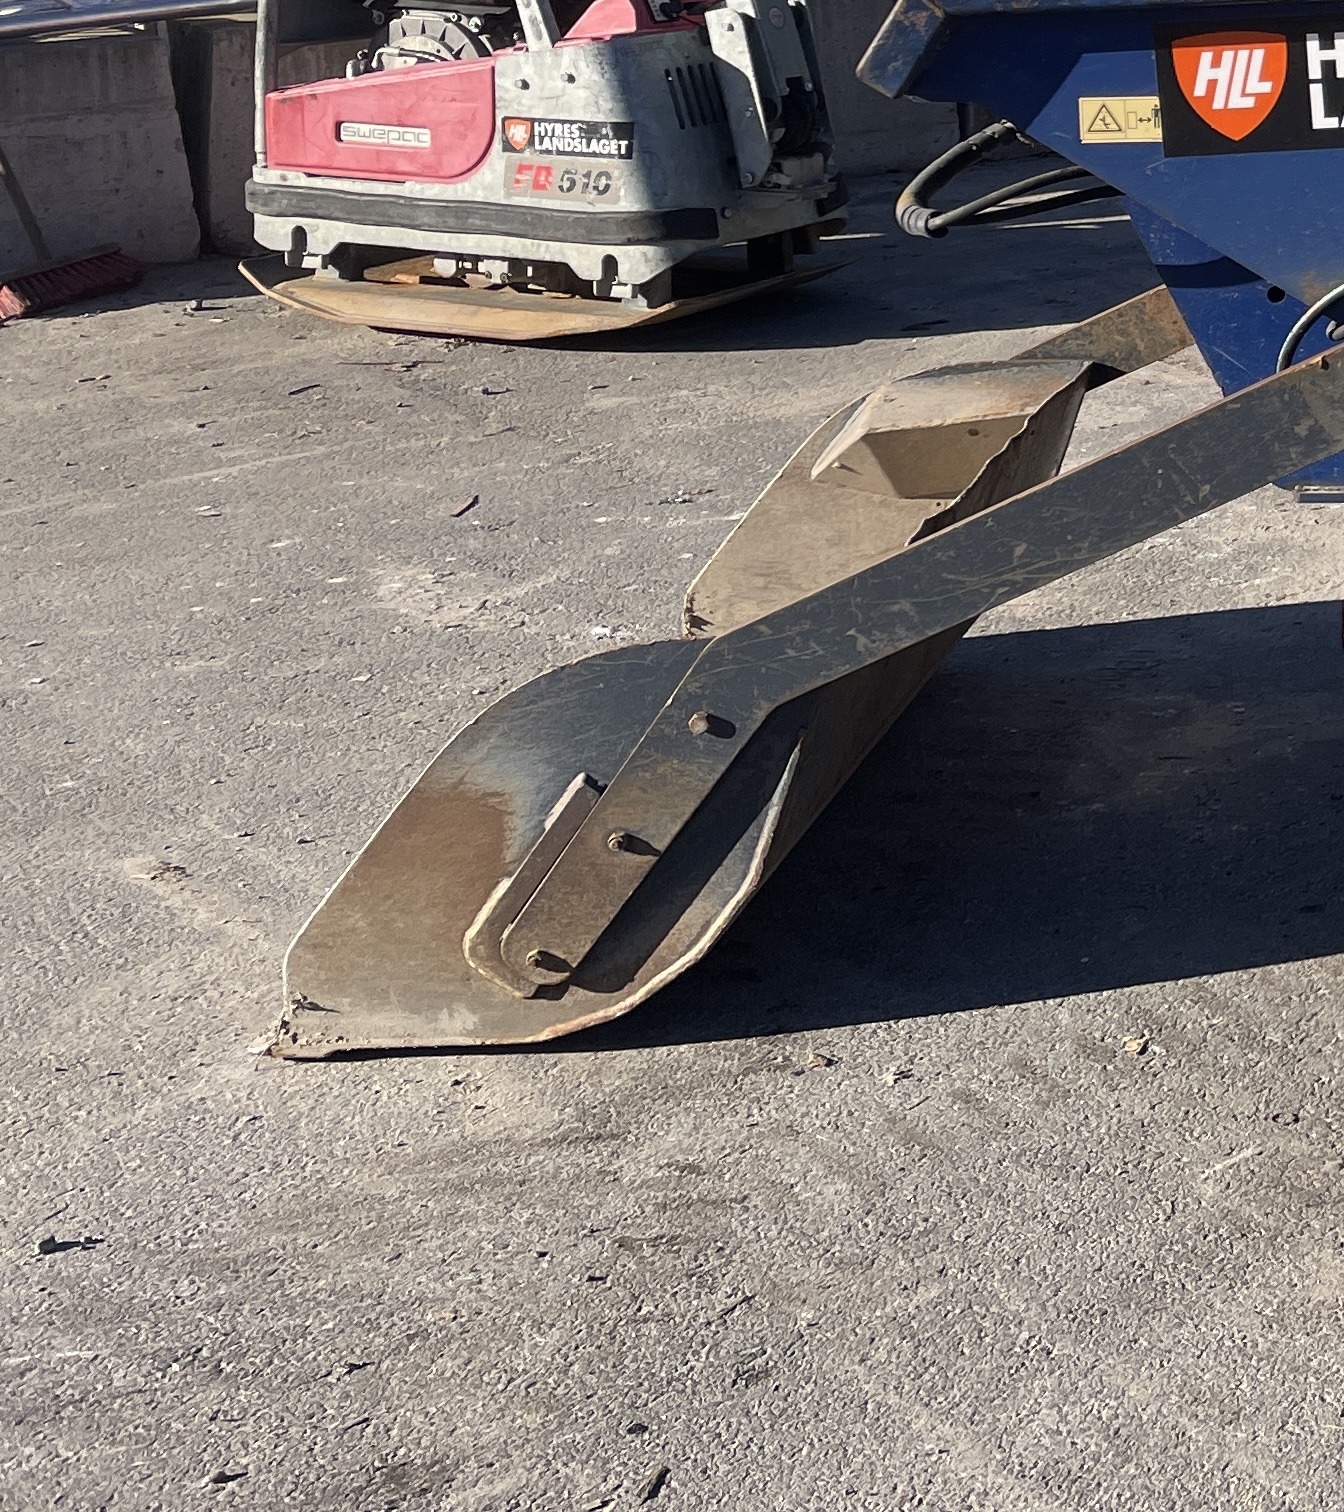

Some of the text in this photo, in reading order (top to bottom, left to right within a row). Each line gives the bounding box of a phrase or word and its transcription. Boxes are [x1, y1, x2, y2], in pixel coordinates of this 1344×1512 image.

[1193, 48, 1273, 111] HLL
[342, 124, 430, 145] swepac
[533, 121, 580, 138] HYRES
[533, 135, 629, 156] LANDSLAGET
[557, 166, 613, 196] 510
